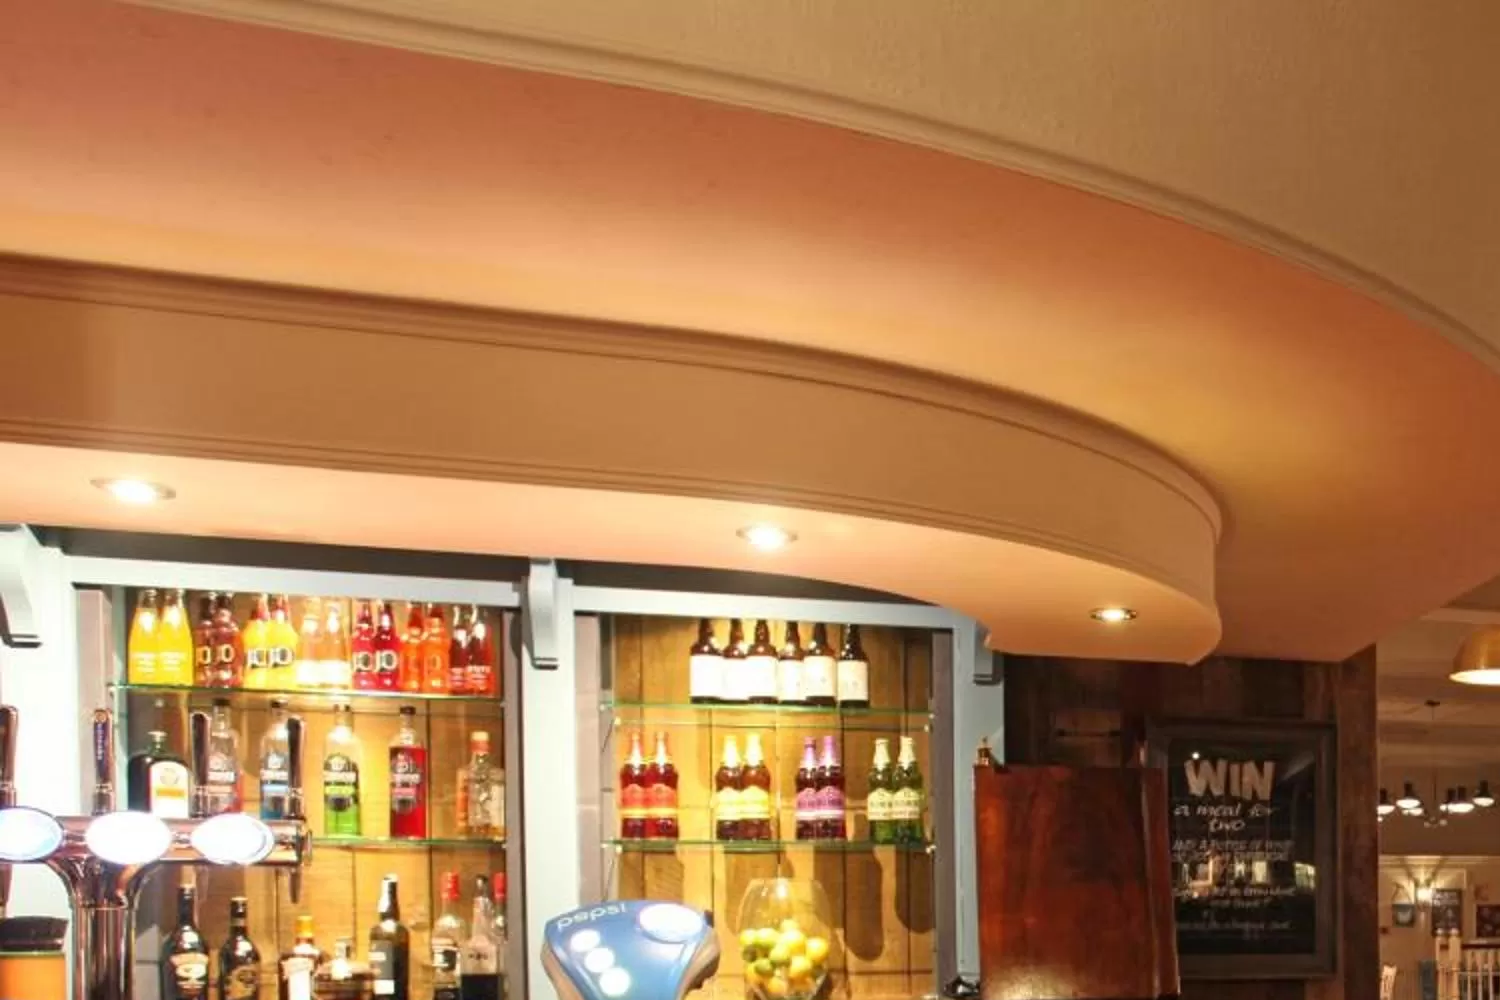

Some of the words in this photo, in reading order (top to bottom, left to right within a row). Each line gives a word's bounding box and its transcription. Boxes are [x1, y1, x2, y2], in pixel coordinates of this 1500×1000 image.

[1184, 759, 1276, 801] WIN
[1209, 818, 1246, 833] two
[557, 902, 626, 932] pepsi
